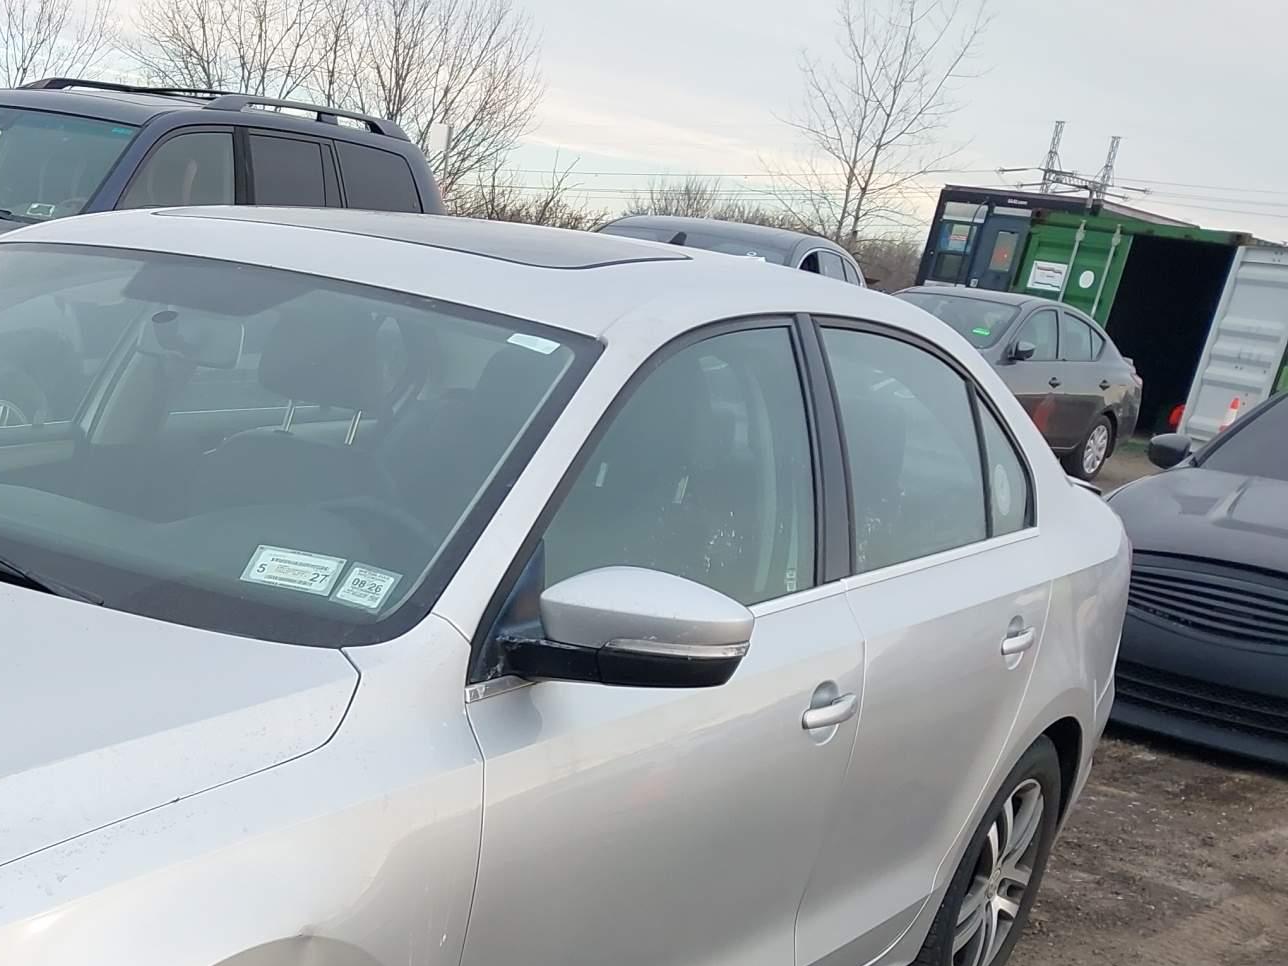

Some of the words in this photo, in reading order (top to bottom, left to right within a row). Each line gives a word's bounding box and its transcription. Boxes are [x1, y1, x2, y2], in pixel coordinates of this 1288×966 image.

[256, 563, 268, 574] 5
[309, 572, 330, 585] 27
[351, 577, 365, 588] 08
[367, 583, 383, 594] 26
